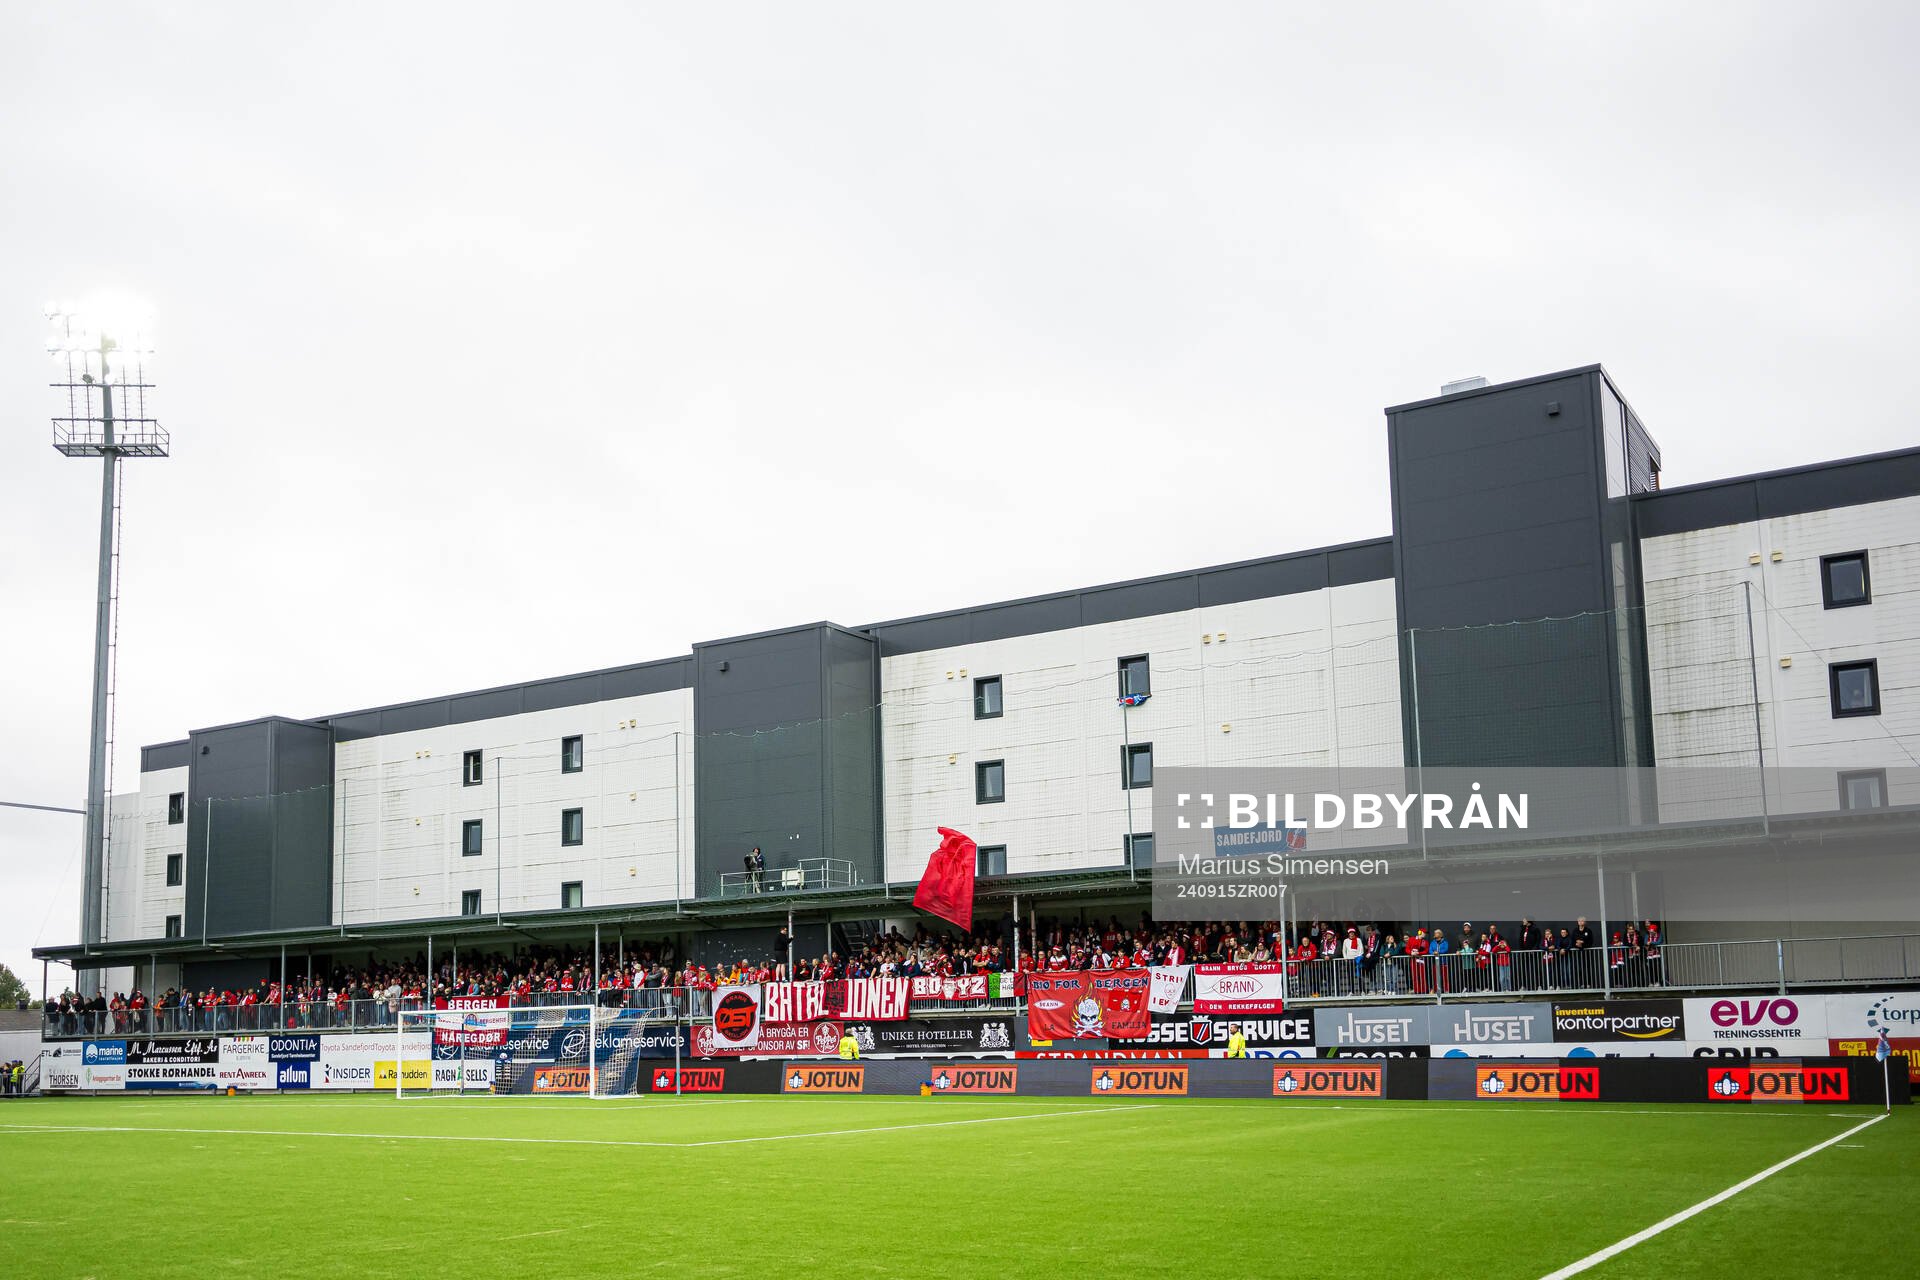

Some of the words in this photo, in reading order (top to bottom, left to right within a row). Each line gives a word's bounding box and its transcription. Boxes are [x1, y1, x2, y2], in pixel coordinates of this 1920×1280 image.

[1216, 829, 1282, 846] SANDEFJORD
[1055, 979, 1080, 989] FOR
[1095, 977, 1148, 988] BERGEN
[1219, 980, 1254, 994] BRANN
[447, 999, 497, 1011] BERGEN
[1555, 1007, 1605, 1016] inventum
[1710, 998, 1799, 1026] evo
[1556, 1015, 1680, 1032] kontorpartner
[798, 1026, 809, 1037] ER
[881, 1031, 914, 1041] UNIKE
[917, 1030, 974, 1040] HOTELLER
[1713, 1028, 1801, 1039] TRENINGSSENTER
[98, 1044, 123, 1056] marine
[222, 1043, 265, 1054] FARGERIKE
[271, 1038, 317, 1052] ODONTIA
[400, 1041, 432, 1052] andefjord
[128, 1068, 160, 1078] STOKKE
[162, 1067, 216, 1077] RØRHANDEL
[333, 1068, 371, 1079] INSIDER
[465, 1069, 488, 1081] SELLS
[49, 1075, 79, 1085] THORSEN
[671, 1072, 721, 1088] JOTUN
[804, 1071, 860, 1088] JOTUN
[952, 1070, 1013, 1089] JOTUN
[1115, 1071, 1183, 1090] JOTUN
[1300, 1071, 1376, 1092] JOTUN
[1508, 1072, 1592, 1093] JOTUN
[1744, 1072, 1841, 1095] JOTUN
